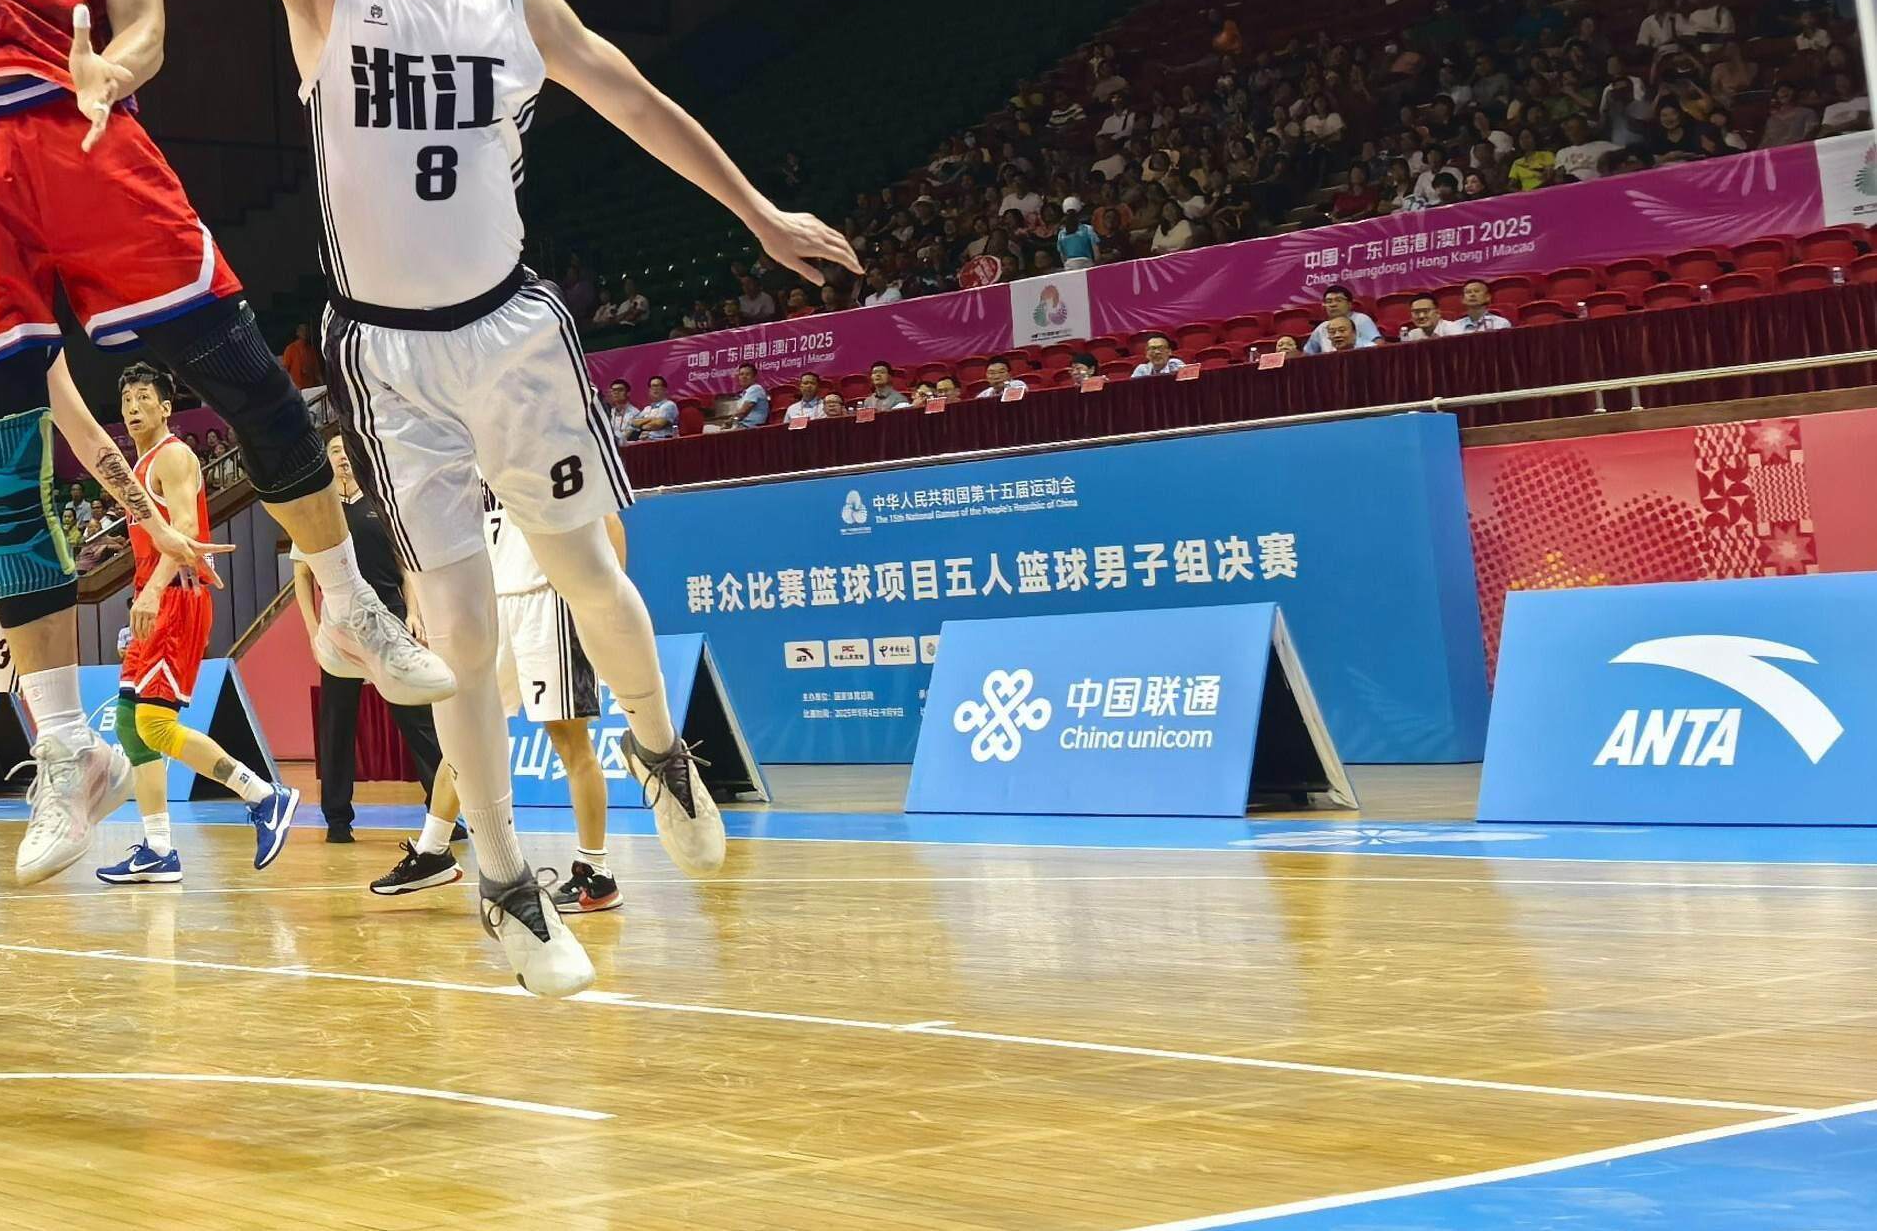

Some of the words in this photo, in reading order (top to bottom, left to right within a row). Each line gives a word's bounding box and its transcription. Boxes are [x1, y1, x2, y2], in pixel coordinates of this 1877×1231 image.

[350, 44, 506, 130] 浙江
[415, 145, 459, 202] 8
[1479, 215, 1533, 243] 2025
[1305, 271, 1339, 287] China
[1340, 261, 1408, 282] Guangdong
[1416, 254, 1449, 272] Hong
[1451, 247, 1484, 265] Kong
[1492, 239, 1536, 258] Macao
[799, 330, 834, 352] 2025
[550, 454, 584, 500] 8
[872, 475, 1076, 513] 中华人民共和国第十五届运动会
[490, 517, 502, 545] 7
[686, 531, 1299, 616] 群众比赛篮球项目五人篮球男子组决赛
[532, 680, 547, 705] 7
[1066, 675, 1222, 719] 中国联通
[1059, 726, 1124, 750] China
[1126, 726, 1214, 750] unicom
[1592, 707, 1743, 767] ANTA
